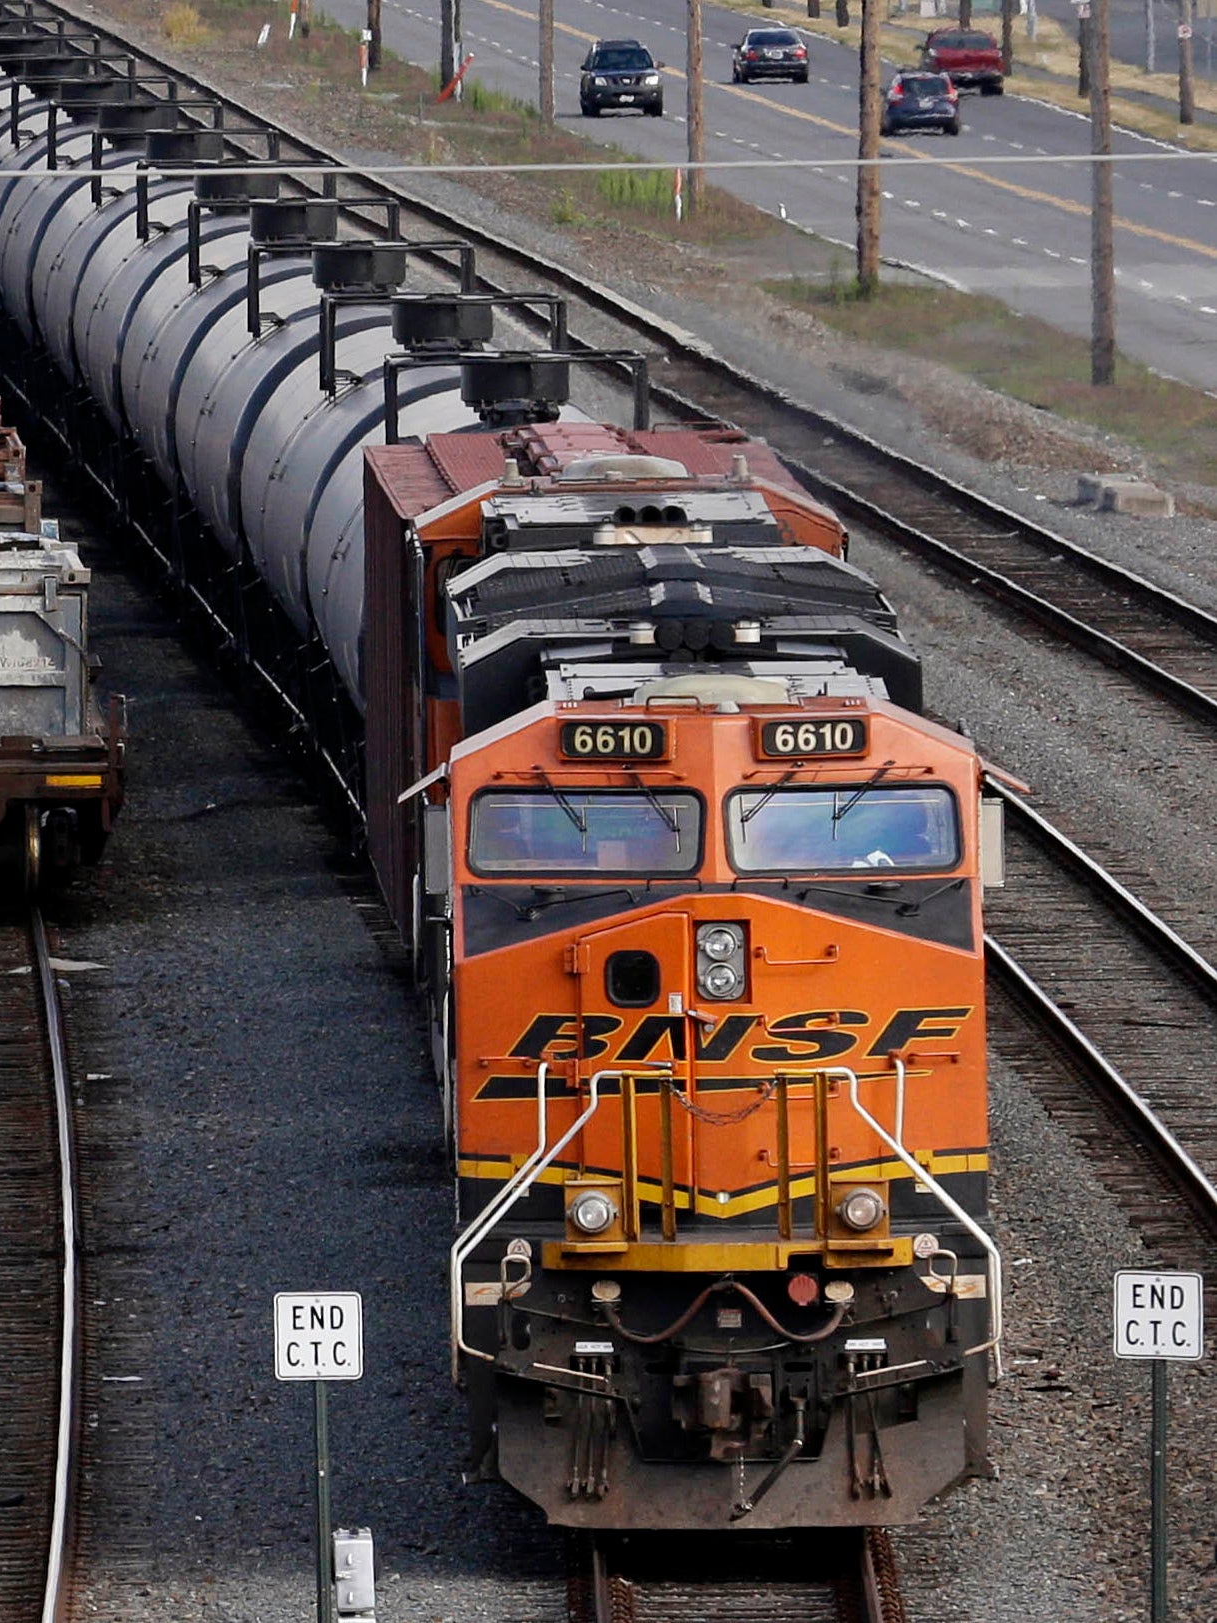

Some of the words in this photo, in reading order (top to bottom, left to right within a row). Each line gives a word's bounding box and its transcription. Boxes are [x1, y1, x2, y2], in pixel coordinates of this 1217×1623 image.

[574, 726, 653, 754] 6610
[775, 723, 854, 752] 6610
[506, 1005, 975, 1063] BNSF
[1132, 1284, 1185, 1310] END
[292, 1305, 344, 1330] END
[1125, 1320, 1191, 1347] C.T.C.
[286, 1341, 351, 1367] C.T.C.
